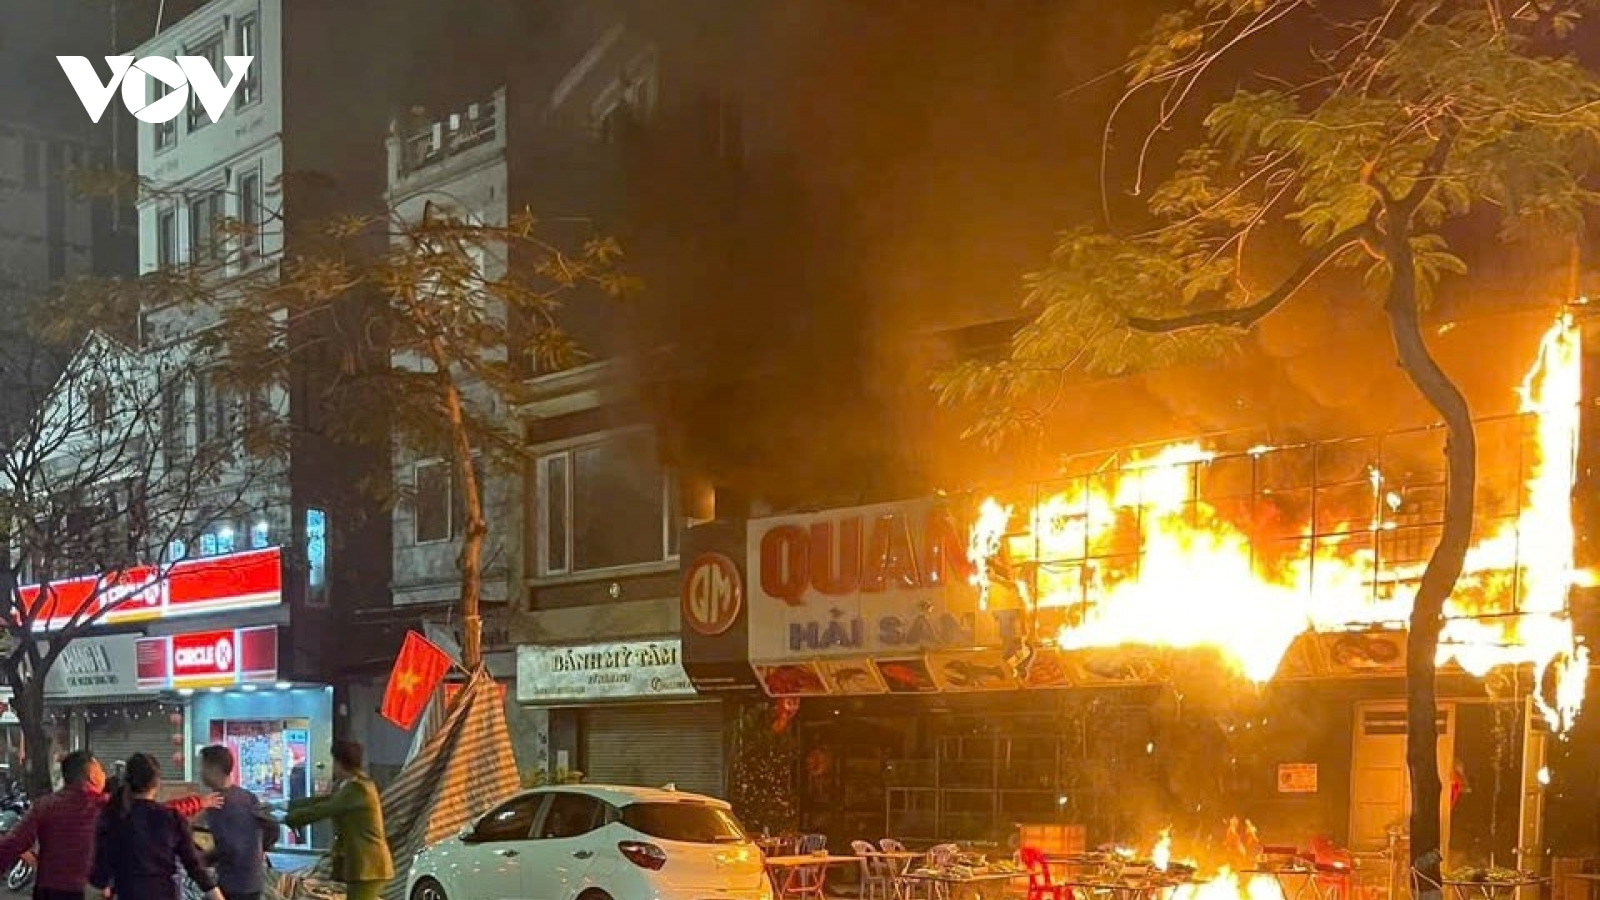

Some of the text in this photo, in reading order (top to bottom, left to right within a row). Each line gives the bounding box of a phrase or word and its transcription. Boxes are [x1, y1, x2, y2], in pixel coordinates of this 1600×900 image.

[789, 606, 864, 651] HẢI
[878, 601, 975, 646] SẢN
[174, 645, 214, 667] CIRCLE
[551, 649, 602, 673] BÁNH
[633, 643, 677, 668] TÂM
